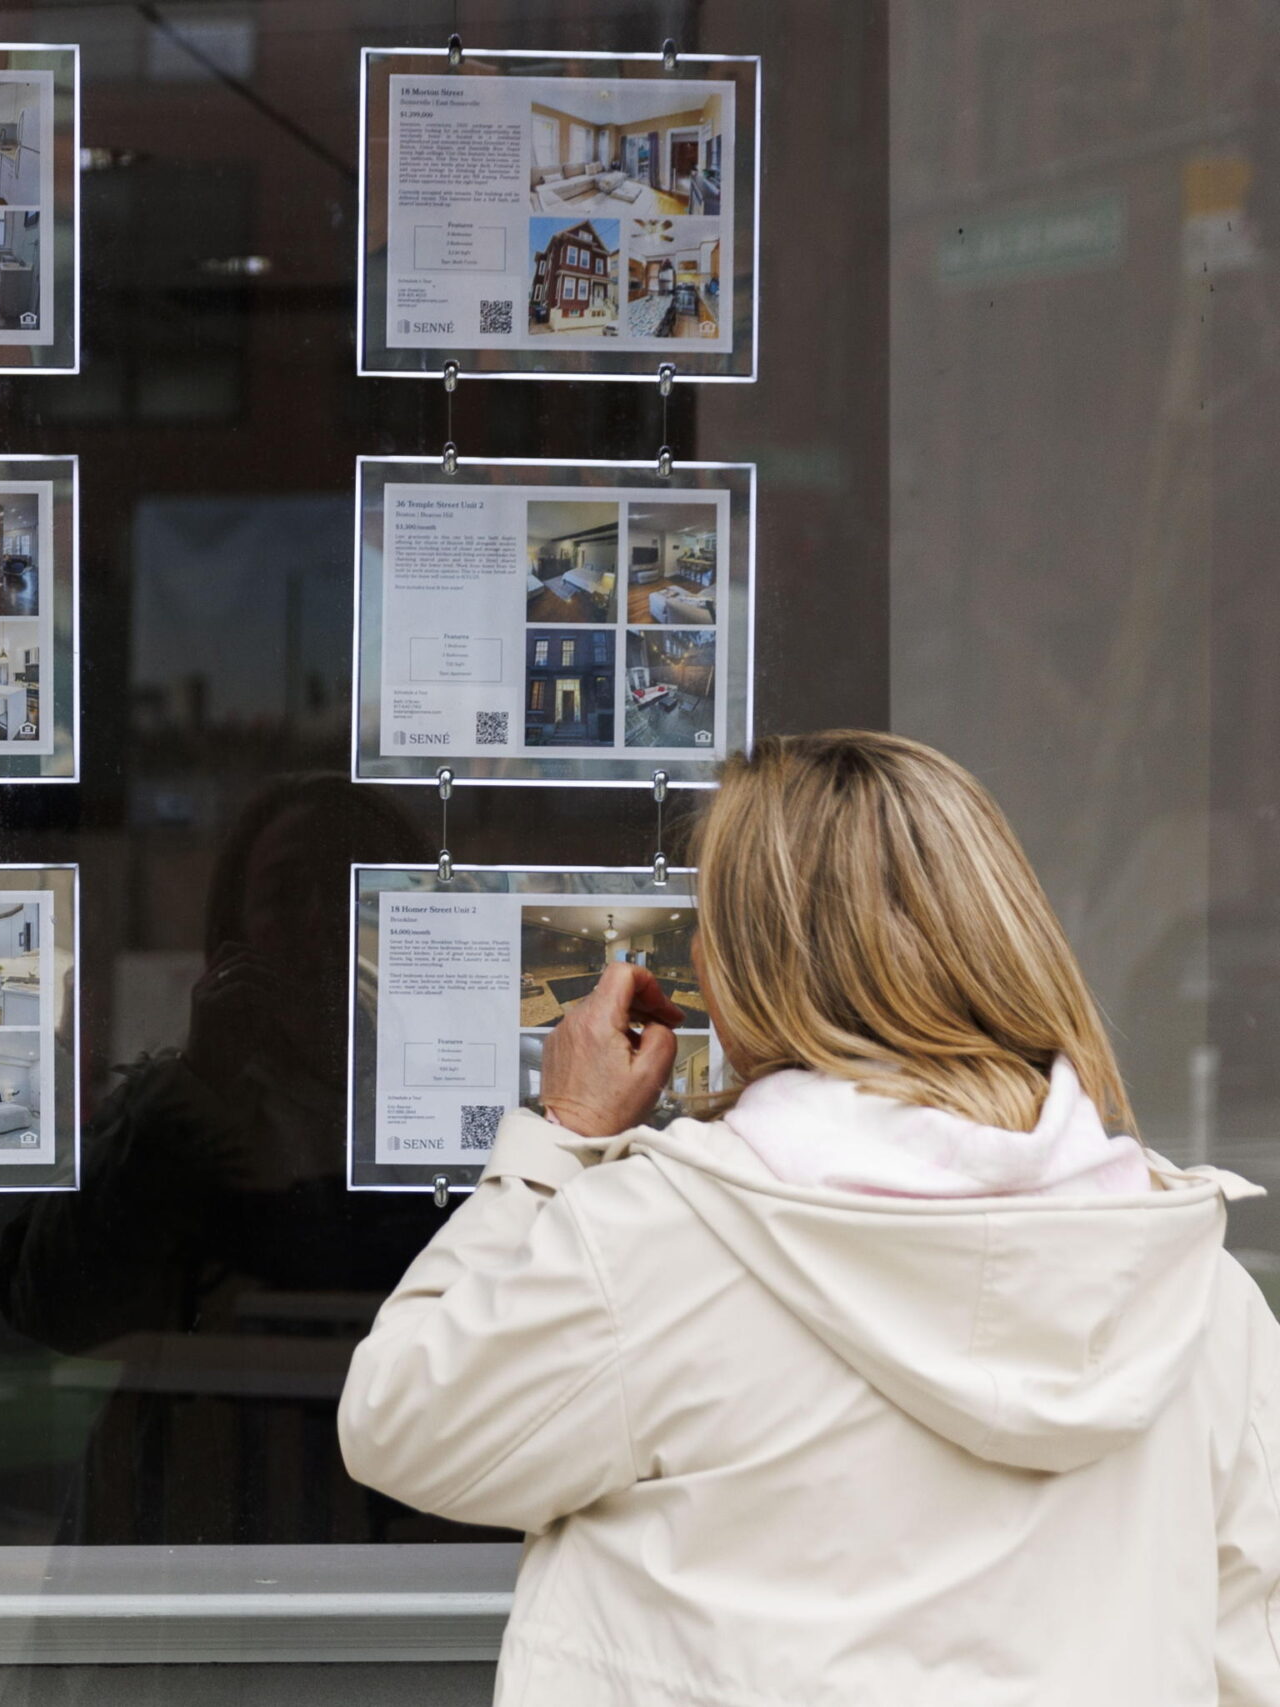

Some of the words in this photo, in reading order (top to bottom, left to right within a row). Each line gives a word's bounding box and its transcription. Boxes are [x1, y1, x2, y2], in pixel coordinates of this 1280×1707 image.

[412, 88, 439, 96] Morton
[441, 89, 464, 97] Street
[413, 320, 454, 333] SENNÉ
[408, 500, 434, 509] Temple
[461, 501, 477, 509] Unit
[409, 731, 451, 744] SENNÉ
[403, 1137, 444, 1149] SENNÉ
